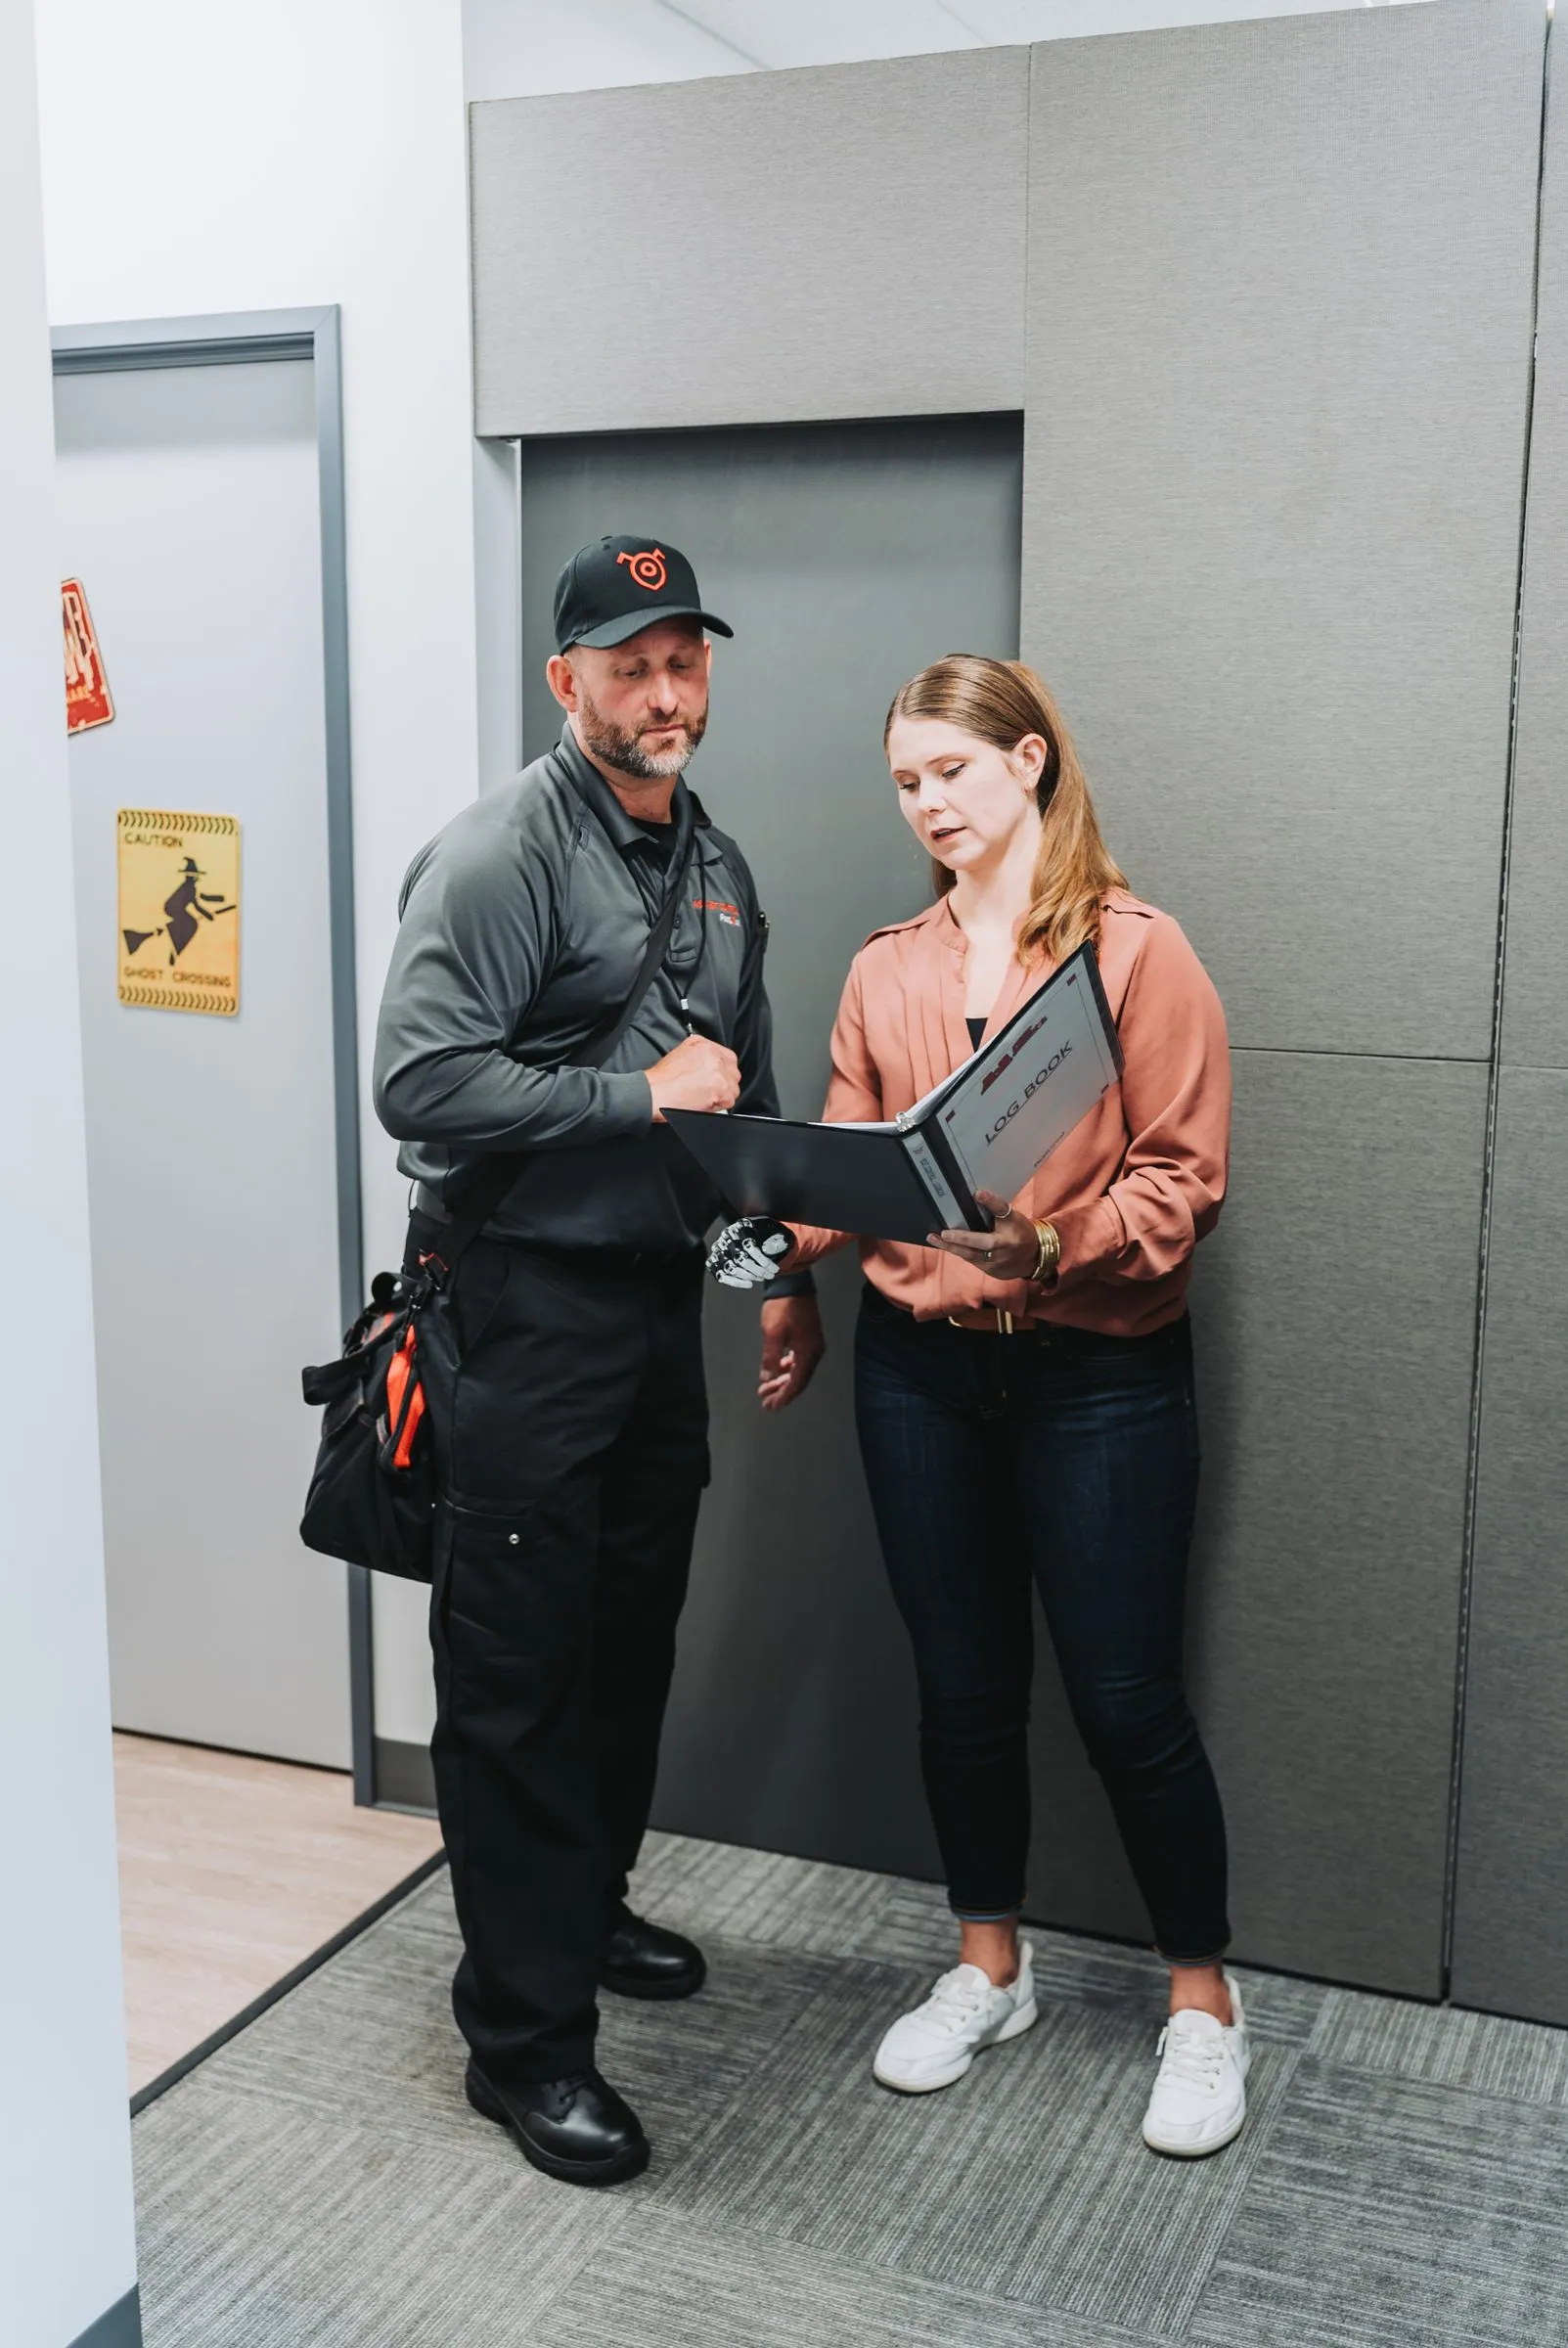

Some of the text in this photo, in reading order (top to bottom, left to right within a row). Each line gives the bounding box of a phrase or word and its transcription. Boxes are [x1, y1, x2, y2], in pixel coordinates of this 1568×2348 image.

[124, 832, 183, 848] CAUTION
[123, 966, 232, 988] GHOST CROSSING
[984, 1100, 1020, 1146] LOG
[1023, 1039, 1073, 1099] BOOK
